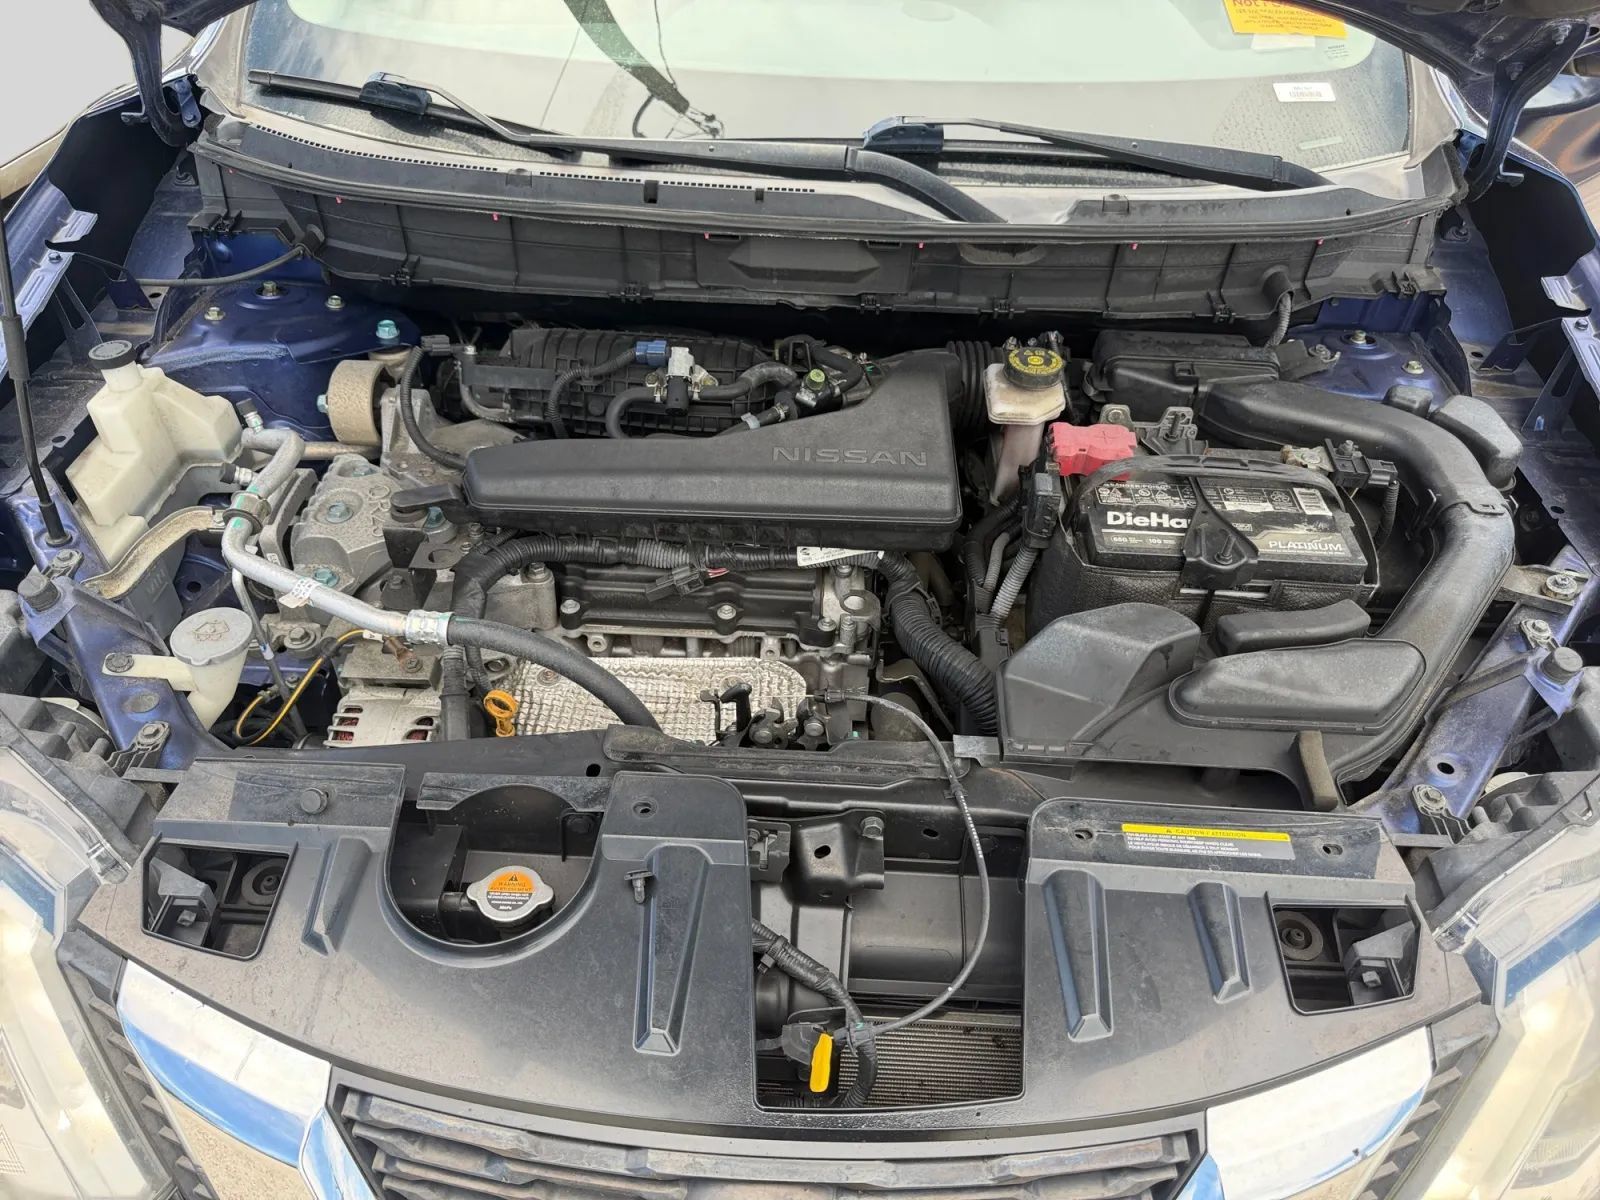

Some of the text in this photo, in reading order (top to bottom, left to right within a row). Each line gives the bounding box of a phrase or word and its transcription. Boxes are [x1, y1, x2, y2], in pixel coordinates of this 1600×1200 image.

[772, 447, 927, 466] NISSAN
[1106, 511, 1191, 529] DieHa
[1269, 541, 1342, 551] PLATINUM
